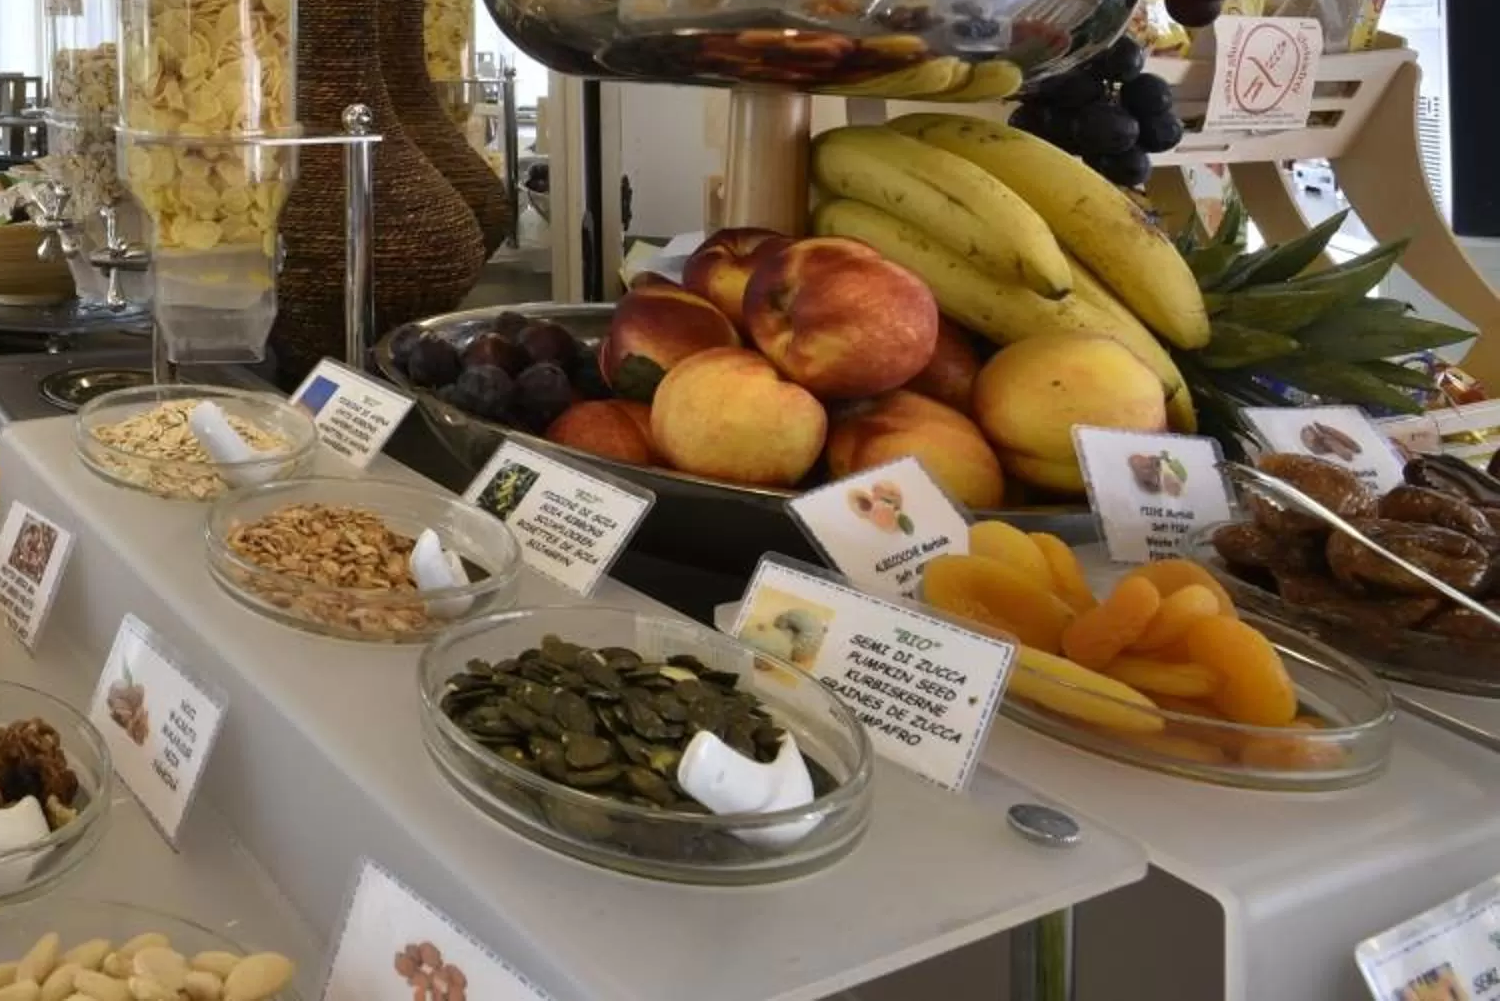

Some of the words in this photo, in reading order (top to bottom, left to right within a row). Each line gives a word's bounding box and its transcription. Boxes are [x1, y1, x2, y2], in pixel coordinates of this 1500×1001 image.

[847, 651, 914, 683] PUMPKIN
[916, 677, 957, 701] SEED
[850, 634, 891, 656] SEMI
[892, 650, 914, 663] DI
[915, 659, 968, 685] ZUCCA
[820, 676, 884, 710] GRAINES
[886, 704, 909, 721] DE
[910, 716, 962, 743] ZUCCA
